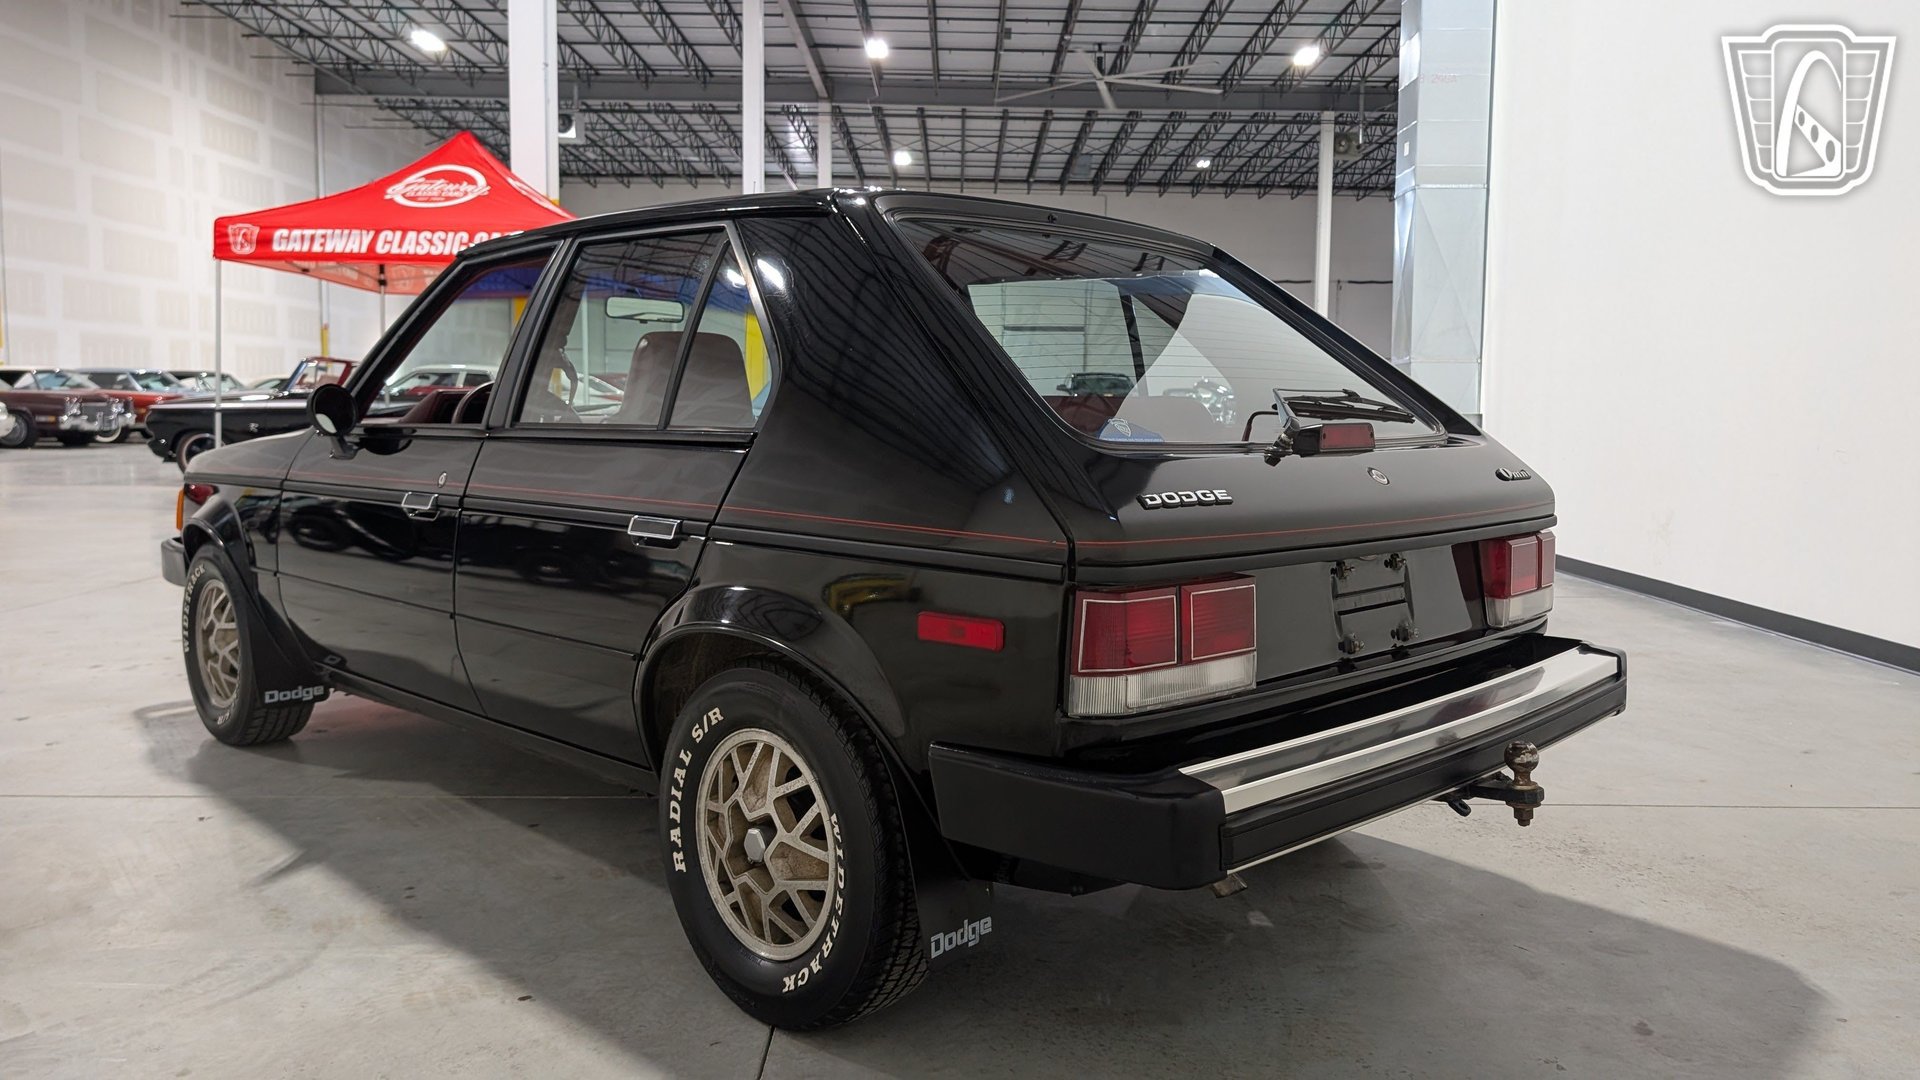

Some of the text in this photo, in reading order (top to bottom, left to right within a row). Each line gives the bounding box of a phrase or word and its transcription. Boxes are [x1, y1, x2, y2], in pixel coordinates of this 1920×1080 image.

[272, 228, 375, 253] GATEWAY
[375, 229, 470, 255] CLASSIC
[1139, 489, 1233, 508] DODGE
[183, 563, 206, 653] WIDETRACK
[264, 685, 325, 704] Dodge
[669, 707, 725, 873] RADIAL S/R
[782, 812, 846, 993] WIDETRACK
[930, 916, 993, 959] Dodge
